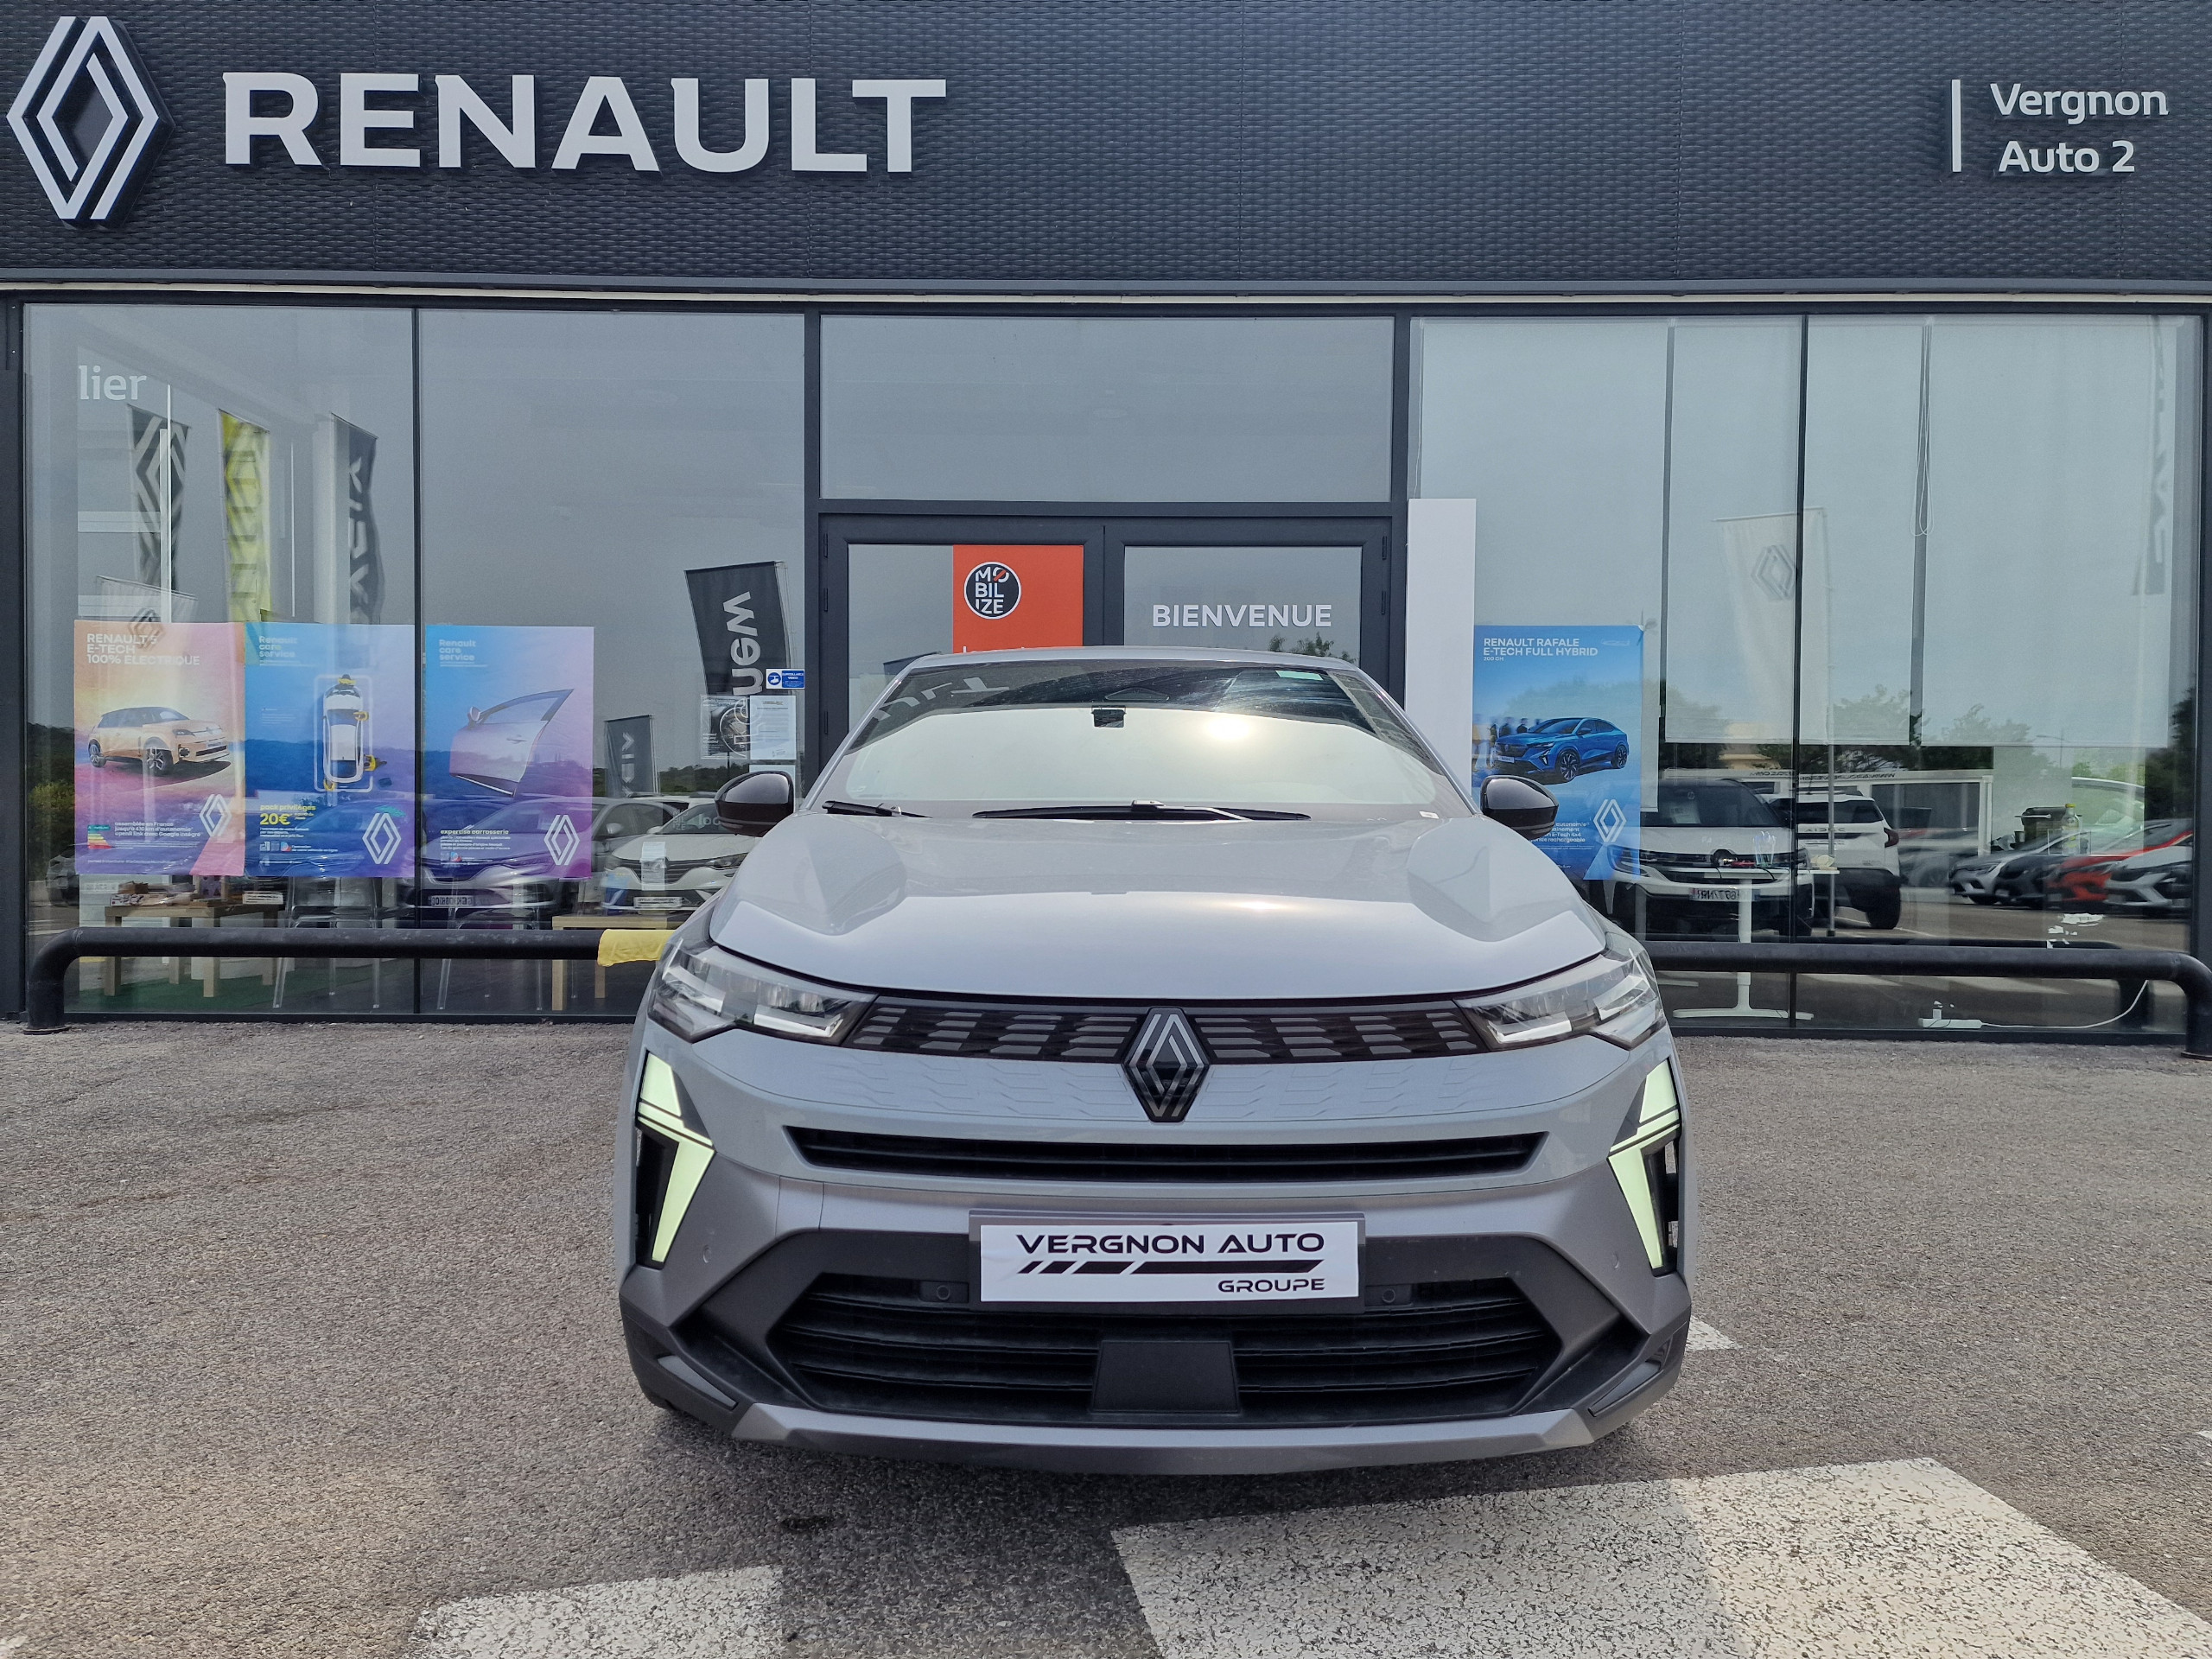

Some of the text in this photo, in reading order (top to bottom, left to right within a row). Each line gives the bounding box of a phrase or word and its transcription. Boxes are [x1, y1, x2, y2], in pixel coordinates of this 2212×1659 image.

[1990, 83, 2170, 125] Vergnon
[222, 72, 947, 173] RENAULT
[1999, 139, 2135, 173] Auto 2
[79, 365, 147, 401] lier
[1153, 604, 1332, 627] BIENVENUE
[86, 633, 148, 645] RENAULT
[439, 639, 476, 647] Renault
[1484, 638, 1580, 647] RENAULT RAFALE
[86, 644, 135, 654] E-TECH
[1484, 646, 1598, 657] E-TECH FULL HYBRID
[86, 654, 121, 664] 100%
[1016, 1232, 1325, 1255] VERGNON AUTO
[1217, 1278, 1325, 1293] GROUPE
